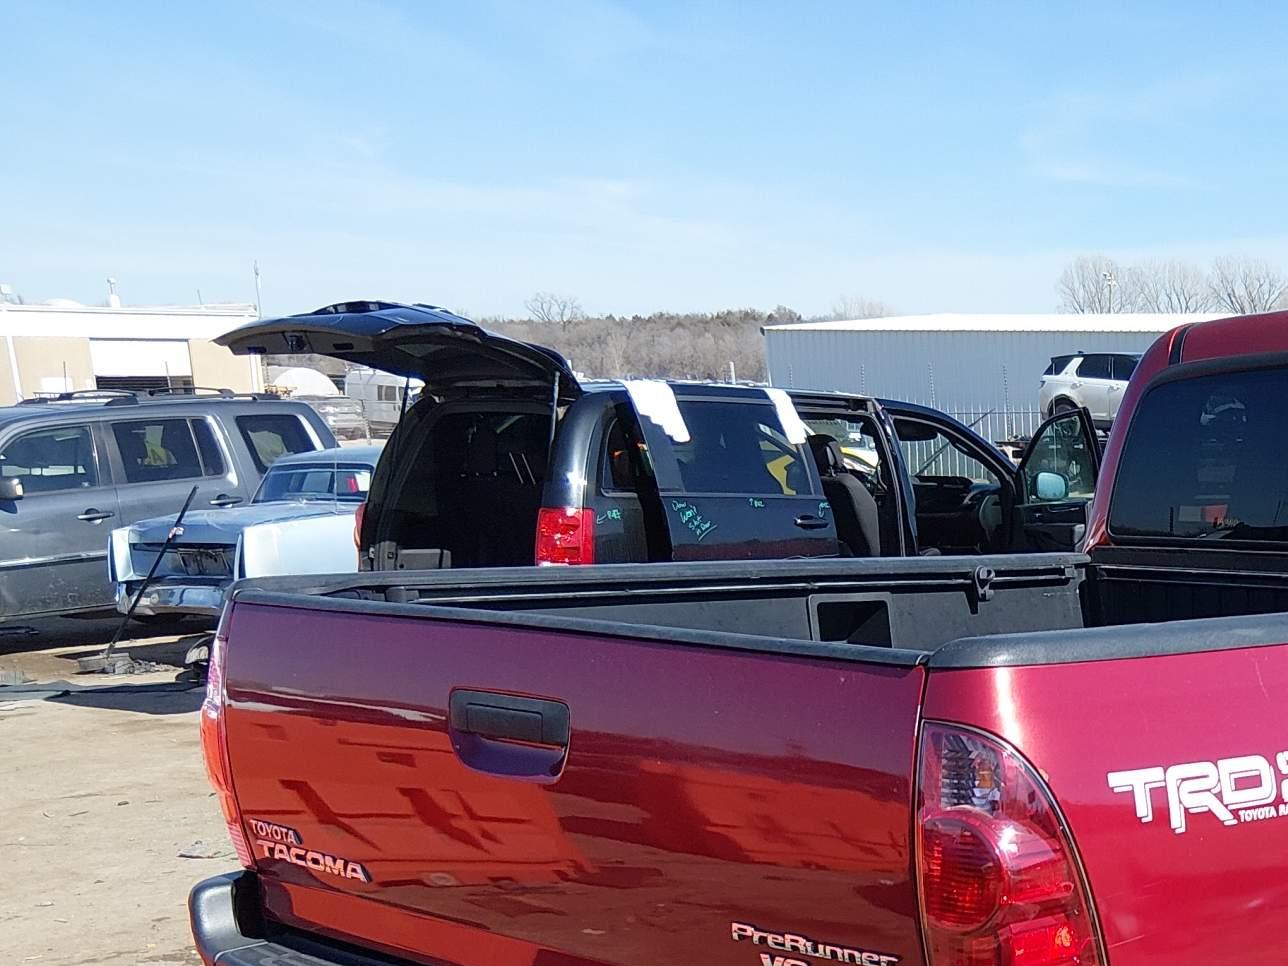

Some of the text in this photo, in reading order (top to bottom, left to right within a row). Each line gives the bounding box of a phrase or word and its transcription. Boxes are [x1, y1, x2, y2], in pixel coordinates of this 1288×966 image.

[1107, 754, 1277, 834] TRD
[1238, 805, 1278, 822] TOYOTA
[249, 818, 300, 846] TOYOTA
[255, 839, 369, 884] TACOMA
